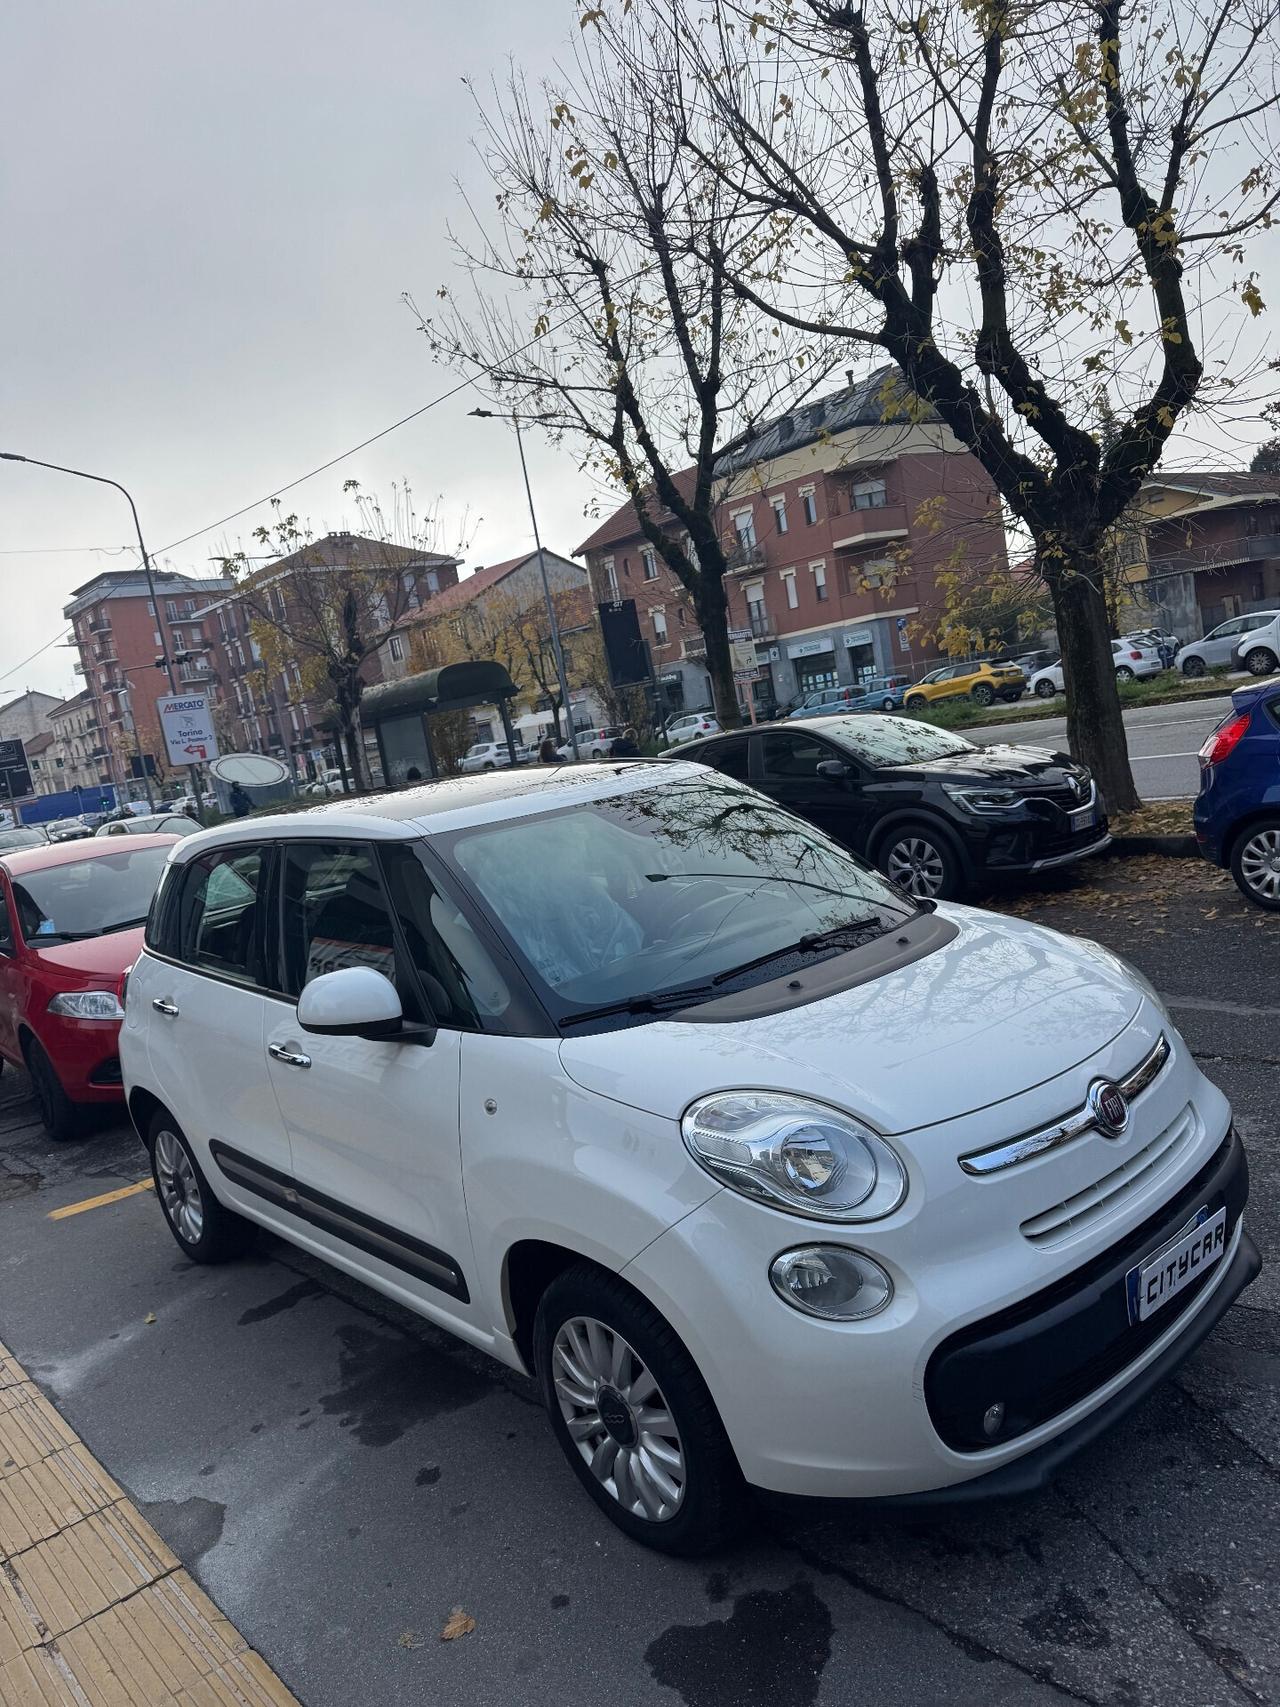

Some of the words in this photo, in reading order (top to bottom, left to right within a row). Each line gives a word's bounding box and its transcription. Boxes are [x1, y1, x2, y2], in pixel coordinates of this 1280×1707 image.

[177, 728, 203, 738] Torino
[1104, 1094, 1124, 1121] FIAT
[1146, 1222, 1224, 1304] CITYCAR
